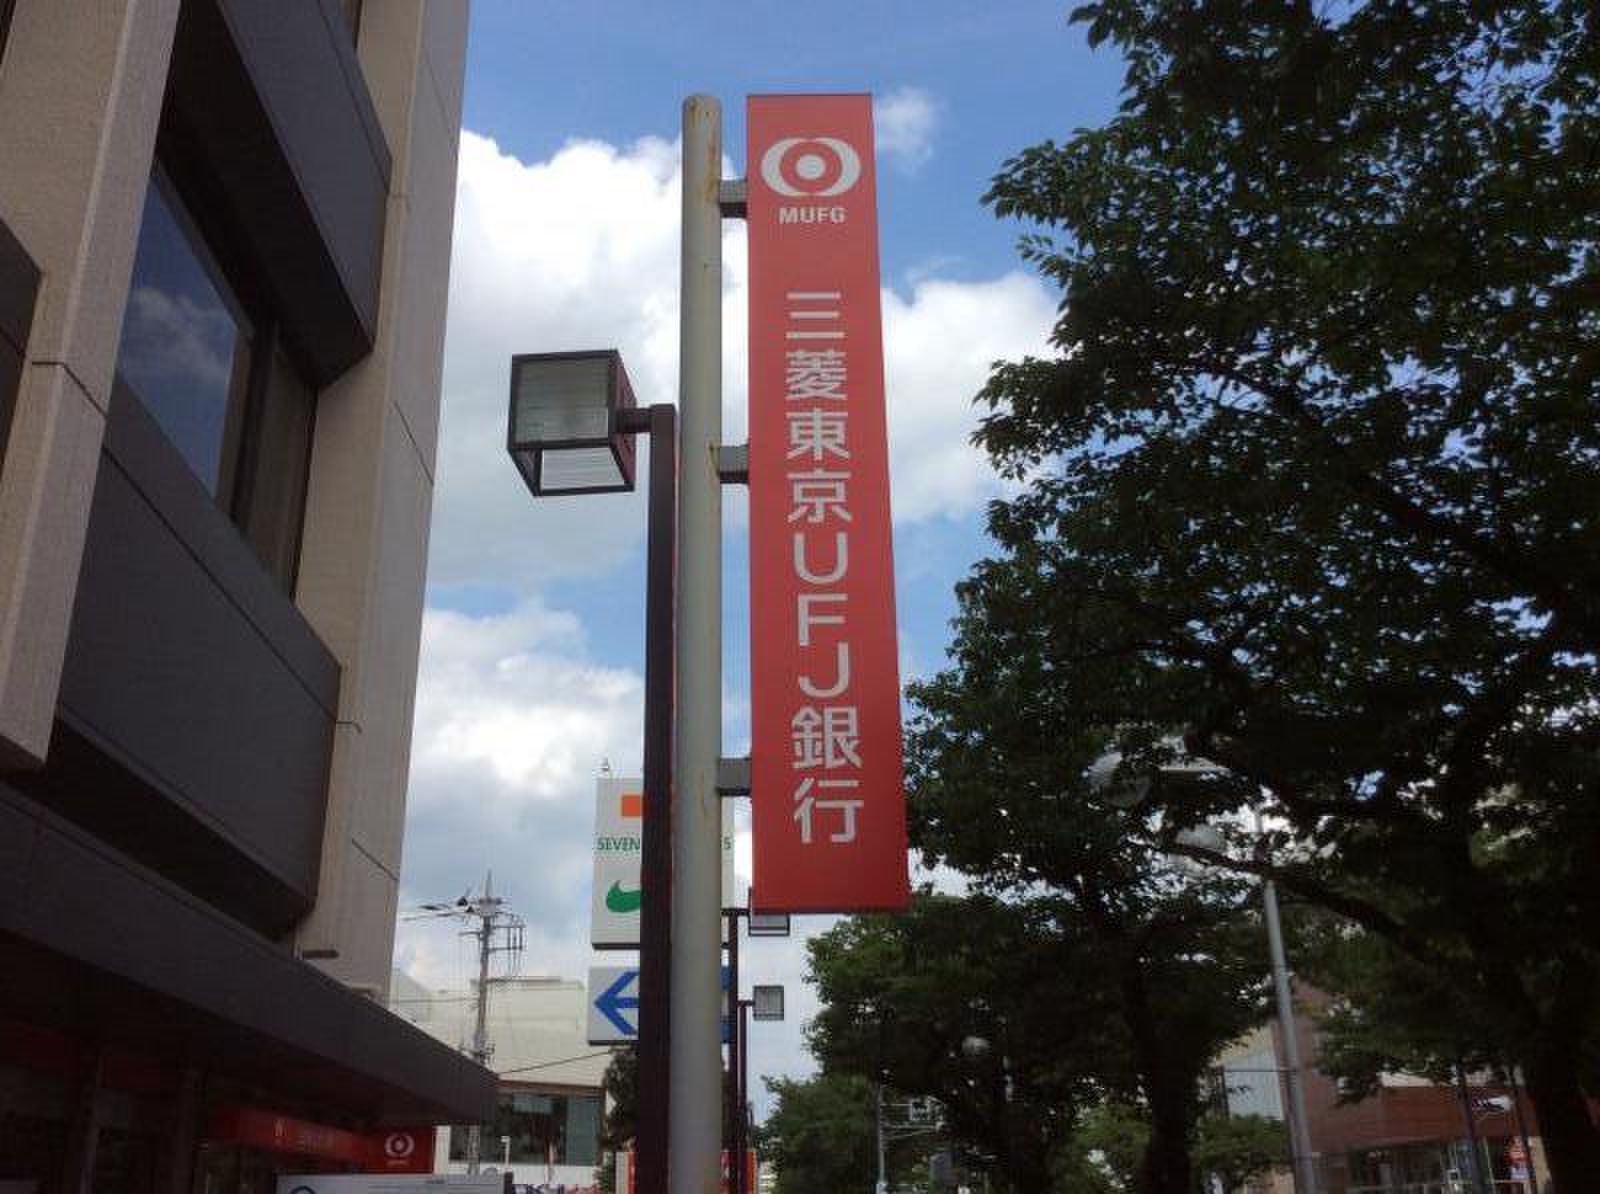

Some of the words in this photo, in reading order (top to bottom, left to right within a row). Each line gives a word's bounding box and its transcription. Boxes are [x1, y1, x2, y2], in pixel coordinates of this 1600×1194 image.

[778, 206, 847, 224] MUFG
[785, 290, 864, 844] 三菱東京UFJ銀行
